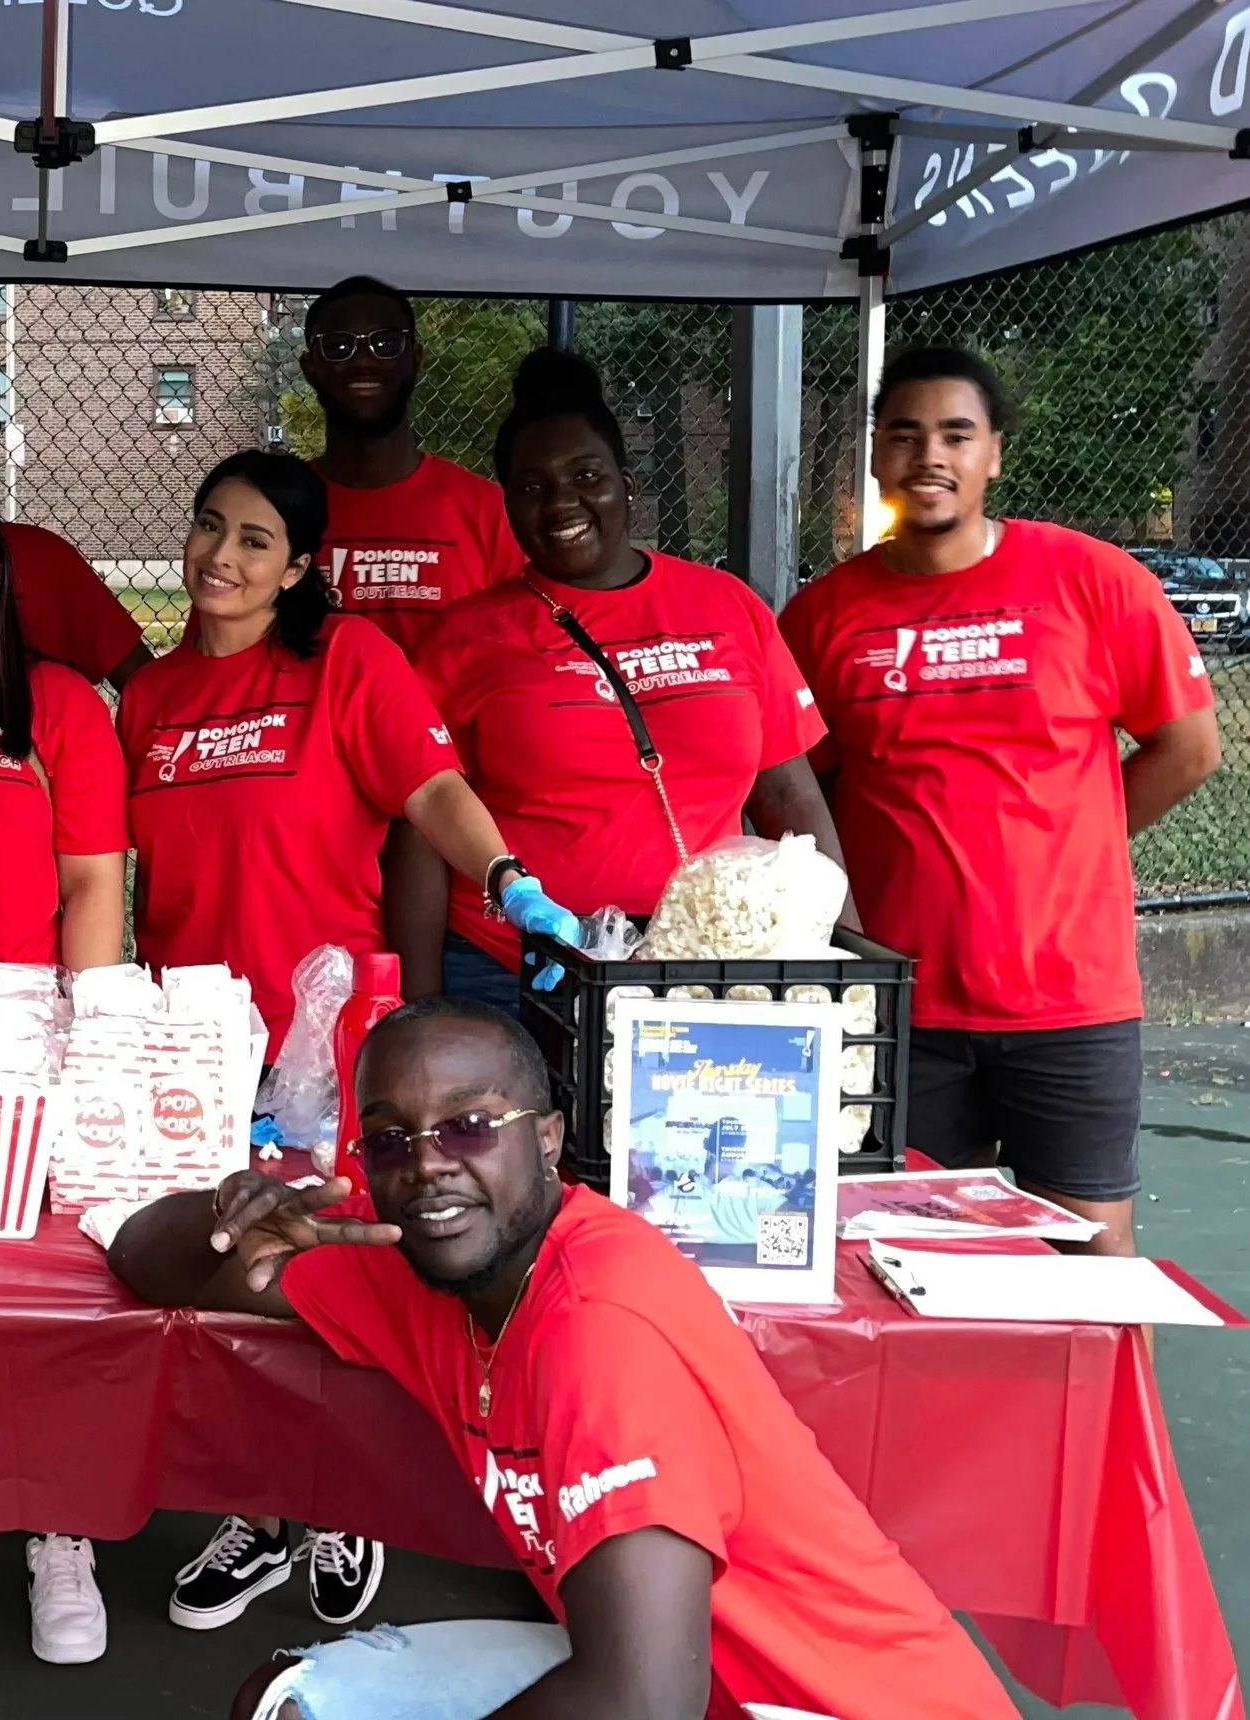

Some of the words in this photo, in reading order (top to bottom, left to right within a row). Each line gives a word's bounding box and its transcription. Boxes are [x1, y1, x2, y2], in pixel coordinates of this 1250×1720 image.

[353, 549, 439, 564] POMONOK
[353, 563, 419, 584] TEEN
[352, 585, 442, 600] OUTREACH
[616, 640, 715, 662] POMONOK
[921, 637, 999, 664] TEEN
[619, 654, 700, 680] TEEN
[624, 668, 732, 695] OUTREACH
[198, 714, 286, 741] POMONOK
[196, 729, 262, 760] TEEN
[189, 750, 286, 772] OUTREACH
[160, 1094, 199, 1112] POP
